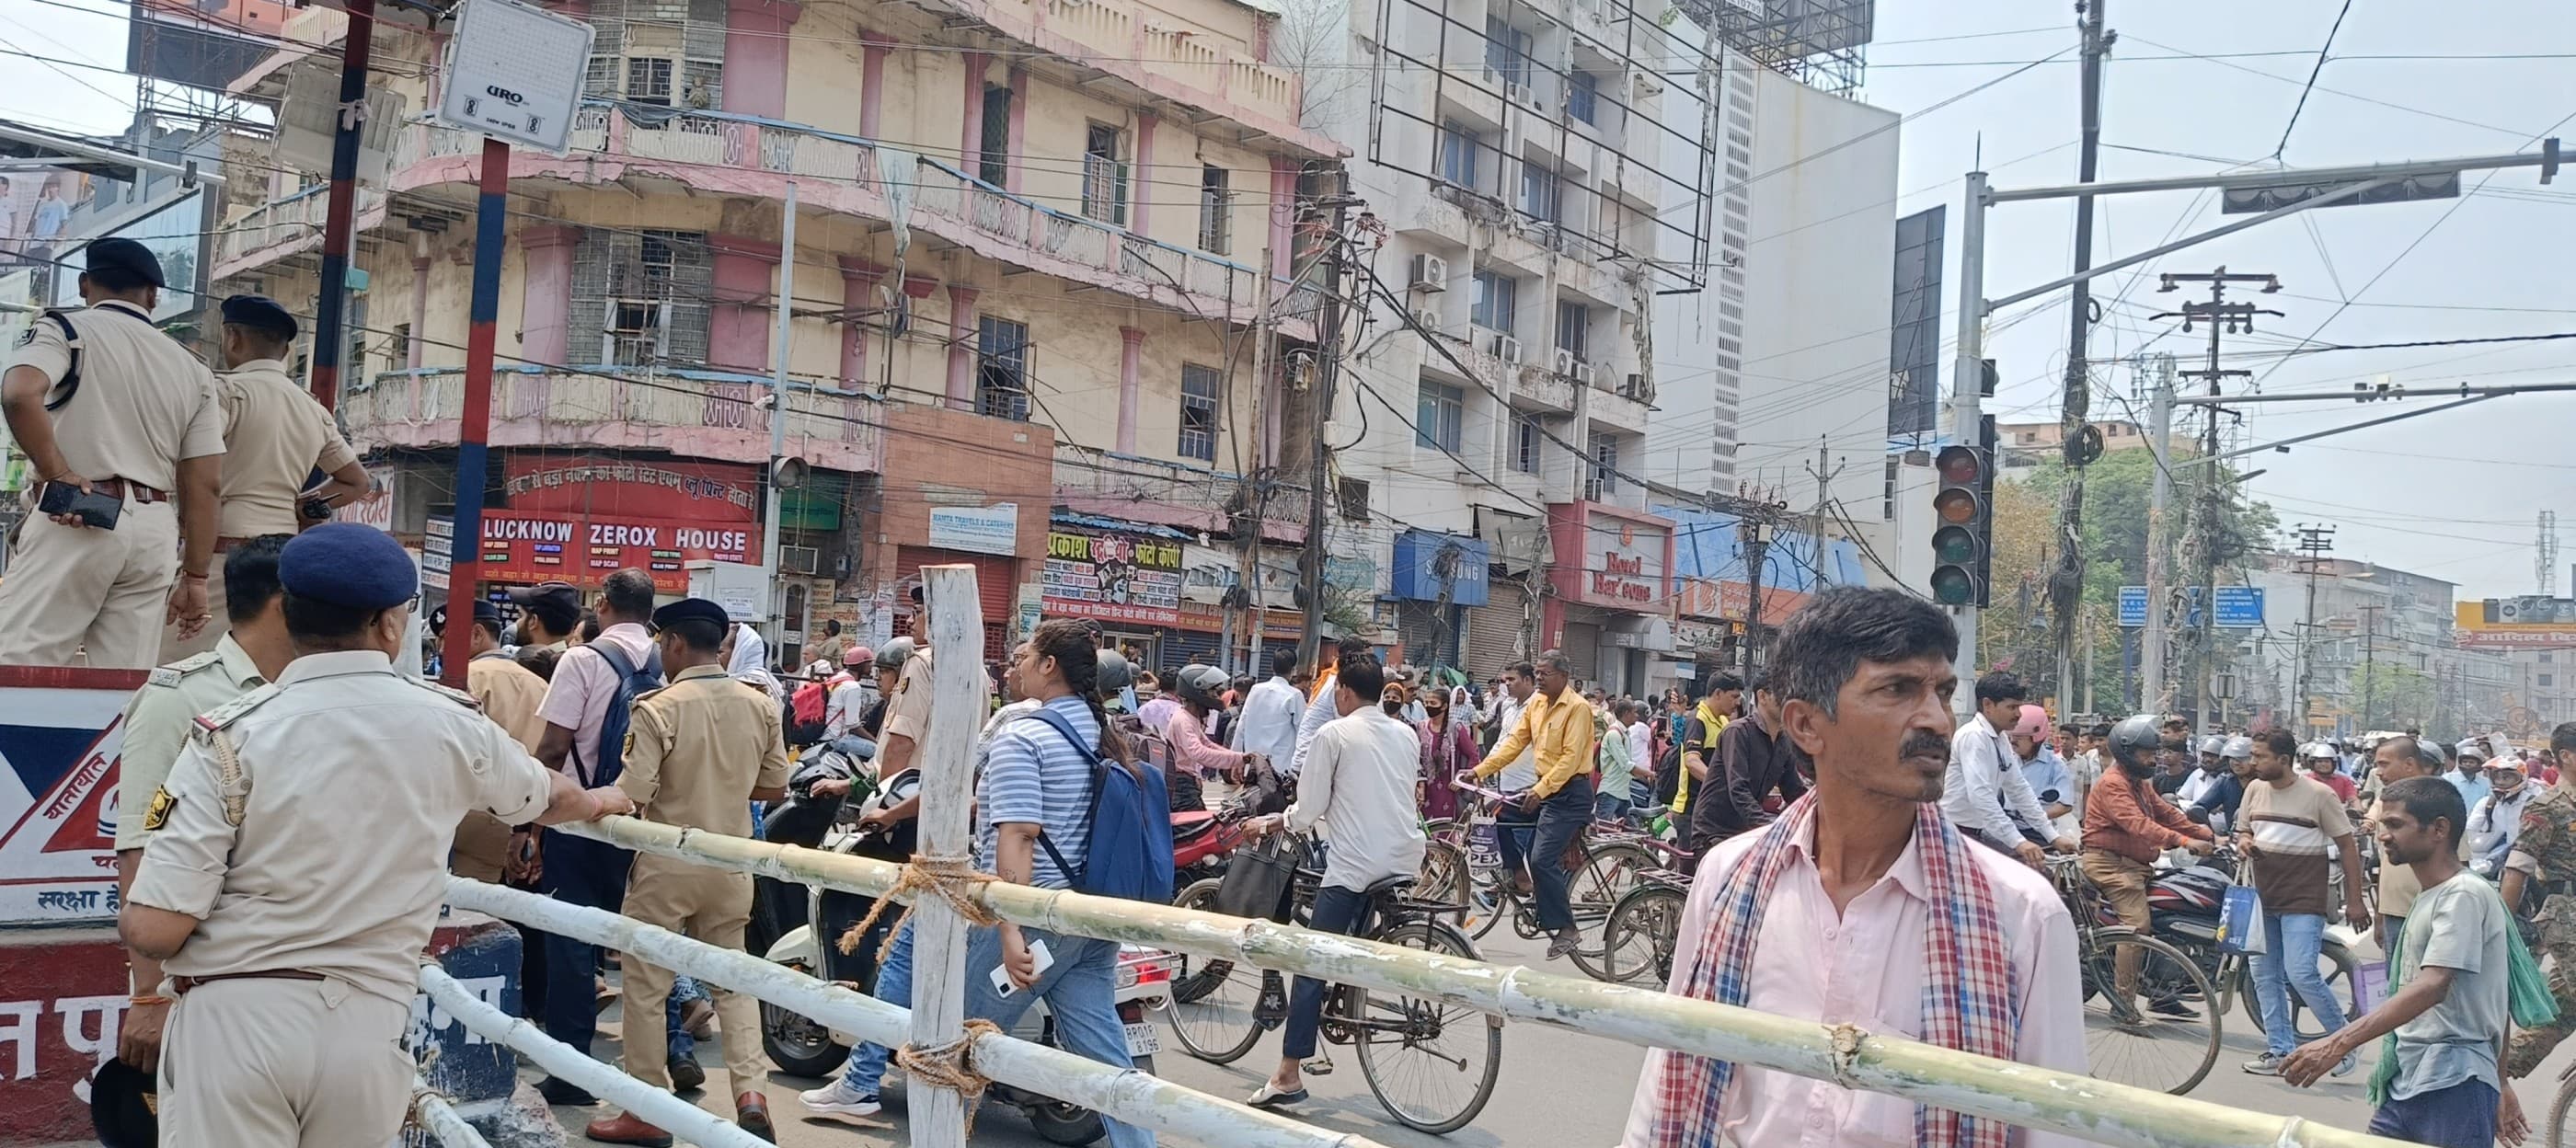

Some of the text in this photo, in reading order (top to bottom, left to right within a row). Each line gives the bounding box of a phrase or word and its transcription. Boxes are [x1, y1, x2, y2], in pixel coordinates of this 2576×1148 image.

[955, 516, 980, 526] TRAVELS
[986, 520, 1014, 529] CATERERS
[484, 519, 746, 551] LUCKNOW ZEROX HOUSE
[1047, 533, 1088, 559] प्रकाश
[1135, 538, 1156, 565] फोटो
[1158, 541, 1181, 568] कॉपी
[1426, 559, 1478, 581] SSUNG
[1606, 551, 1641, 576] Hotel
[43, 752, 107, 820] यातायात
[1471, 851, 1499, 863] PEX
[1136, 1039, 1159, 1053] 8196
